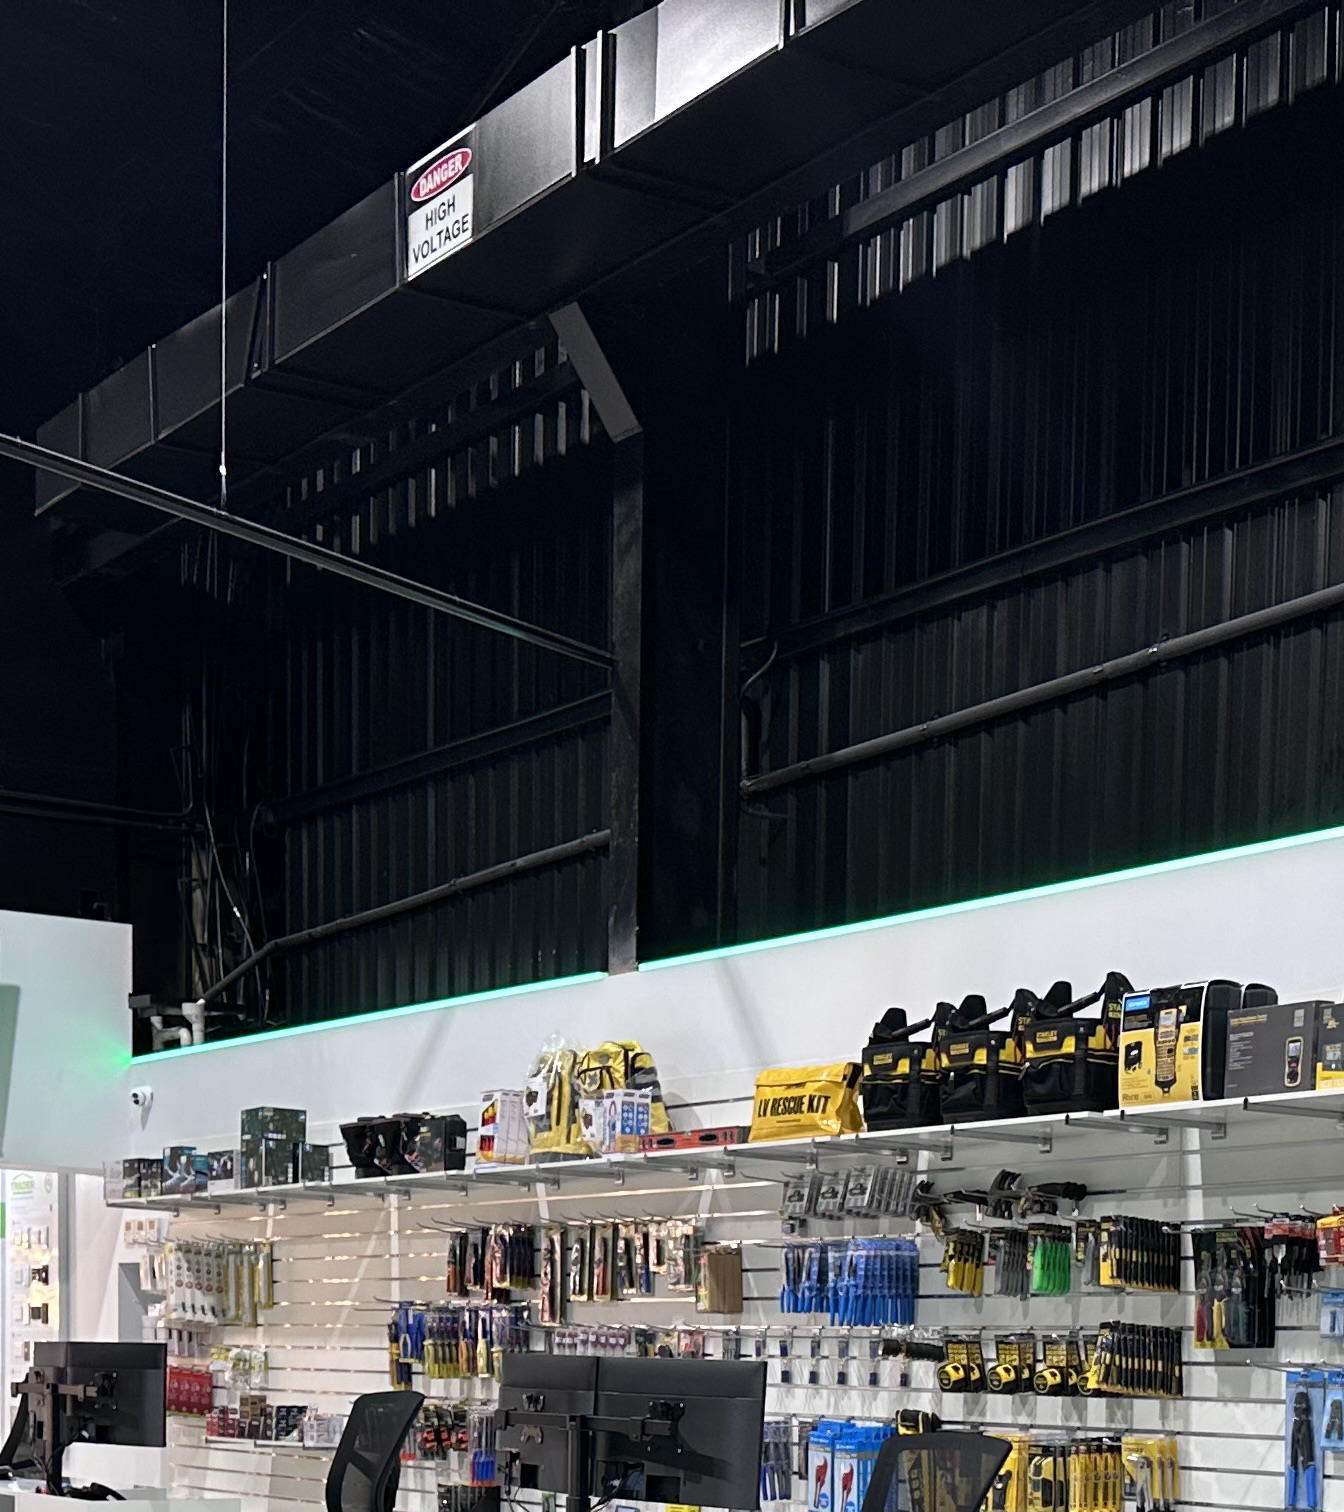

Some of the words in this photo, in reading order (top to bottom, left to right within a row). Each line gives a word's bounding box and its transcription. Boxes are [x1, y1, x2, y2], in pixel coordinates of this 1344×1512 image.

[418, 153, 464, 198] DANGER
[425, 194, 456, 230] HIGH
[412, 213, 470, 264] VOLTAGE
[757, 1098, 771, 1118] LV
[770, 1095, 807, 1117] RESCUE
[806, 1094, 832, 1115] KIT
